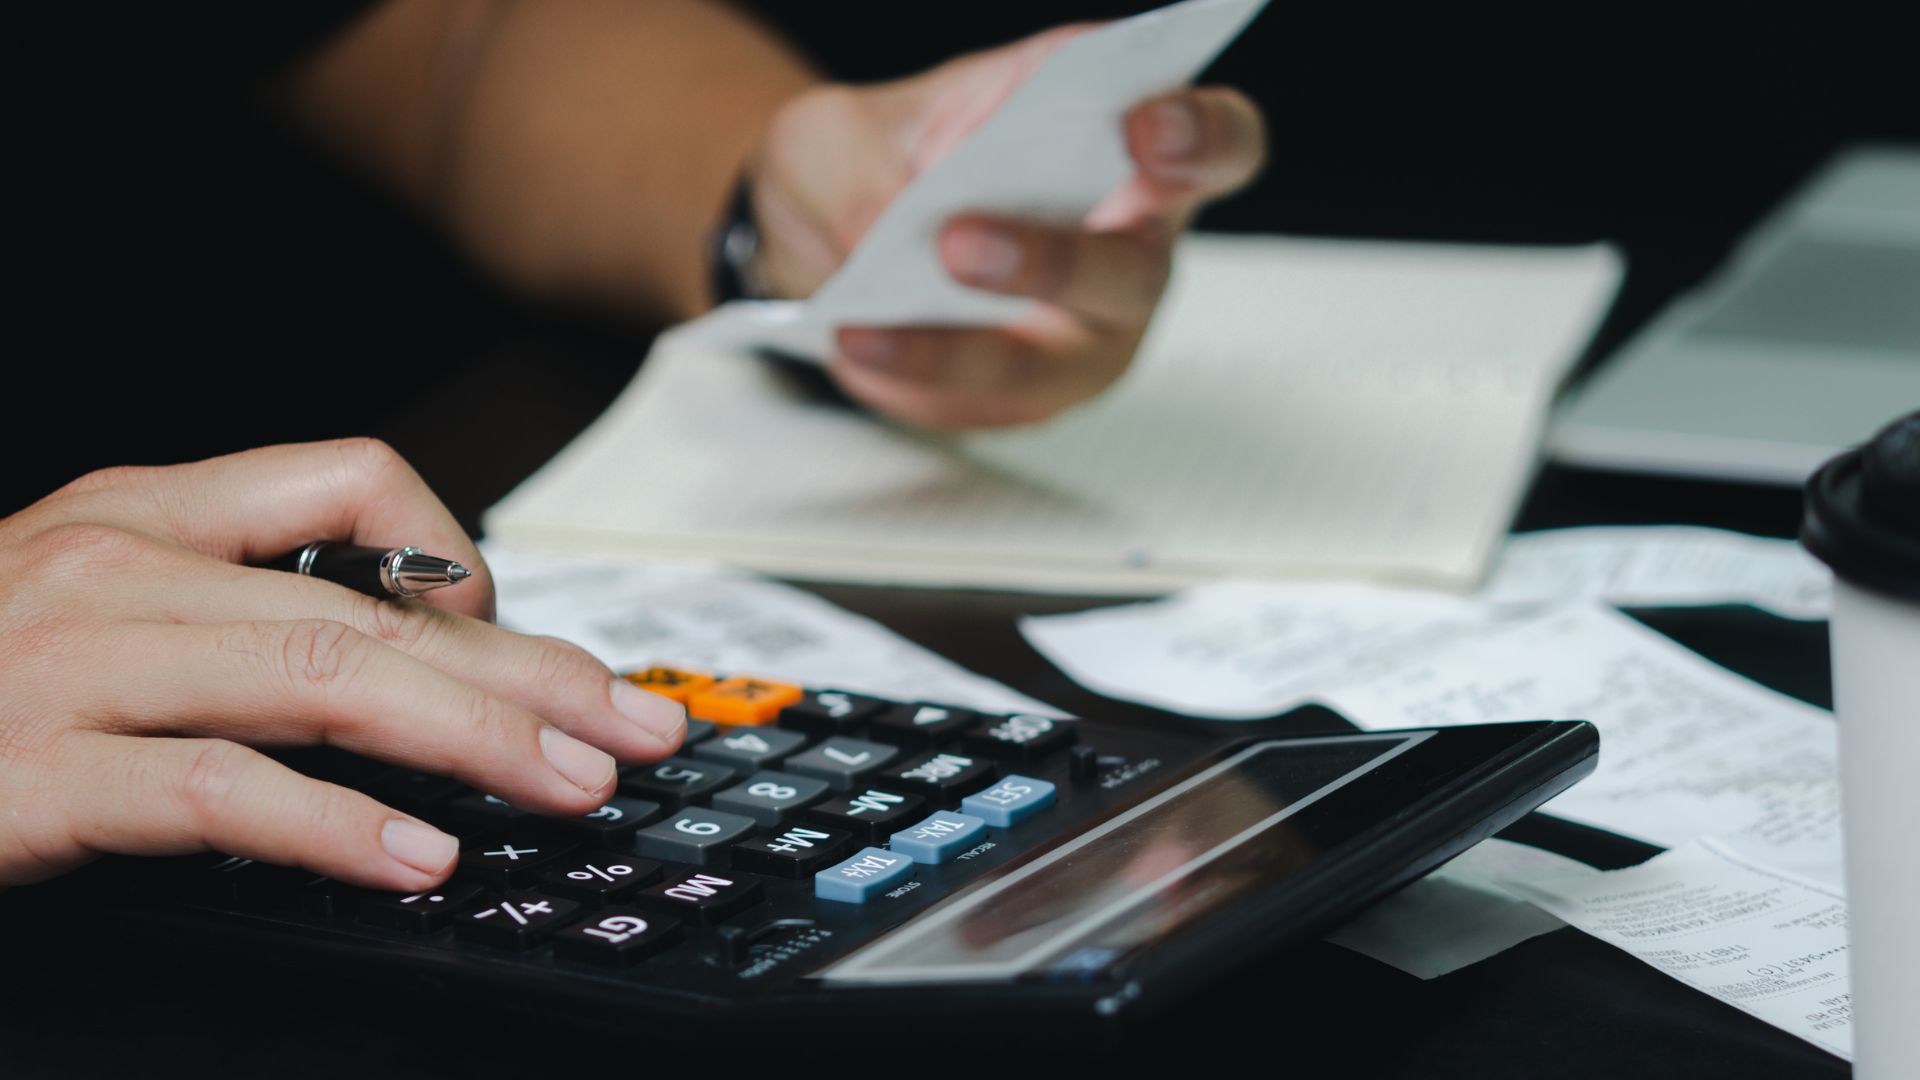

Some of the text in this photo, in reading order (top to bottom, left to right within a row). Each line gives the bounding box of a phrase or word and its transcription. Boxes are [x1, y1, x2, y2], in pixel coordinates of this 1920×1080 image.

[723, 734, 770, 753] 4
[823, 747, 871, 766] 7
[654, 766, 703, 783] 5
[747, 782, 797, 800] 8
[983, 782, 1032, 806] SET
[846, 790, 904, 816] M-
[766, 827, 830, 852] M+
[915, 819, 966, 841] TAX-
[955, 842, 997, 861] RECALL
[567, 864, 633, 882] %
[841, 855, 897, 878] TAX+
[664, 874, 733, 901] MU
[886, 881, 922, 899] STORE
[583, 916, 647, 943] GT
